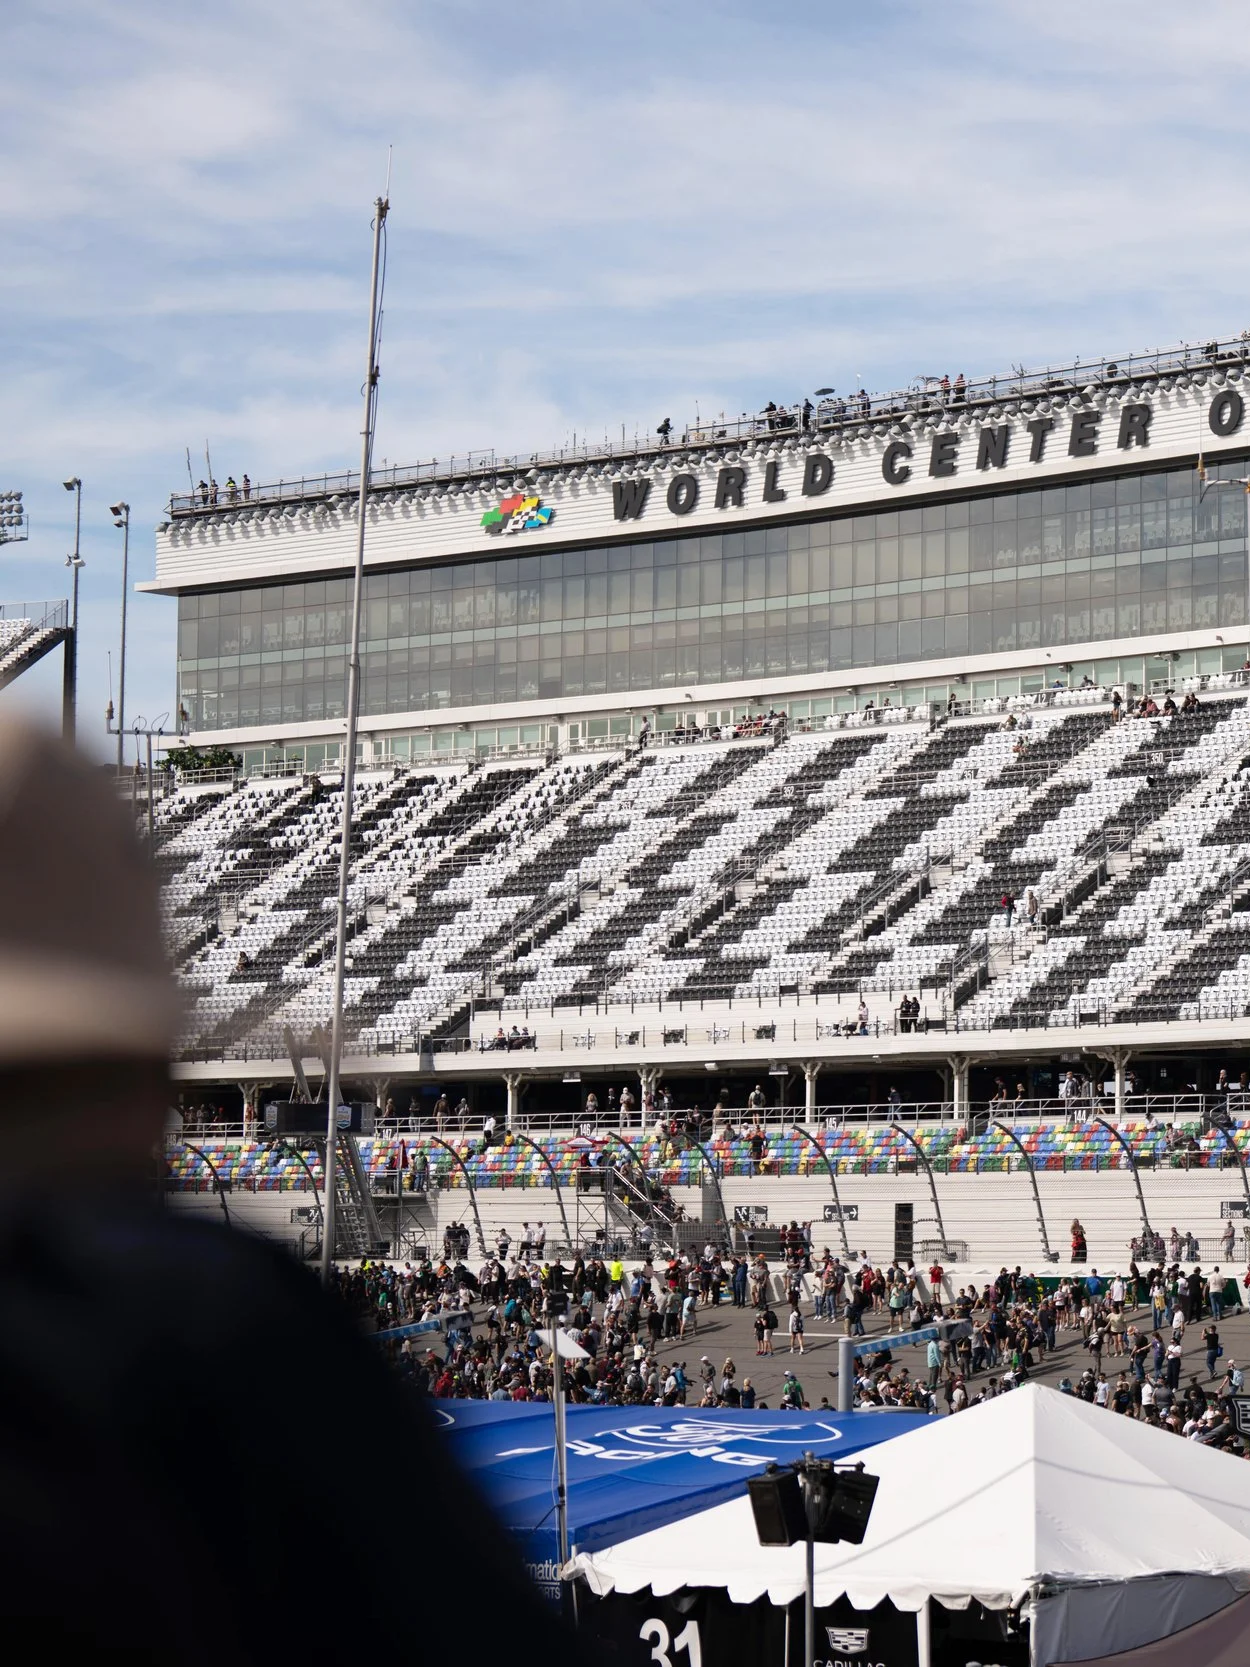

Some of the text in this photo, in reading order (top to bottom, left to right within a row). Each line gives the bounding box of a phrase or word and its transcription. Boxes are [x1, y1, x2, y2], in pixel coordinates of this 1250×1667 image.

[612, 454, 834, 520] WORLD
[882, 403, 1151, 485] CENTER
[825, 1117, 837, 1131] 145
[1073, 1109, 1087, 1124] 144
[579, 1123, 591, 1137] 146
[639, 1617, 703, 1667] 31
